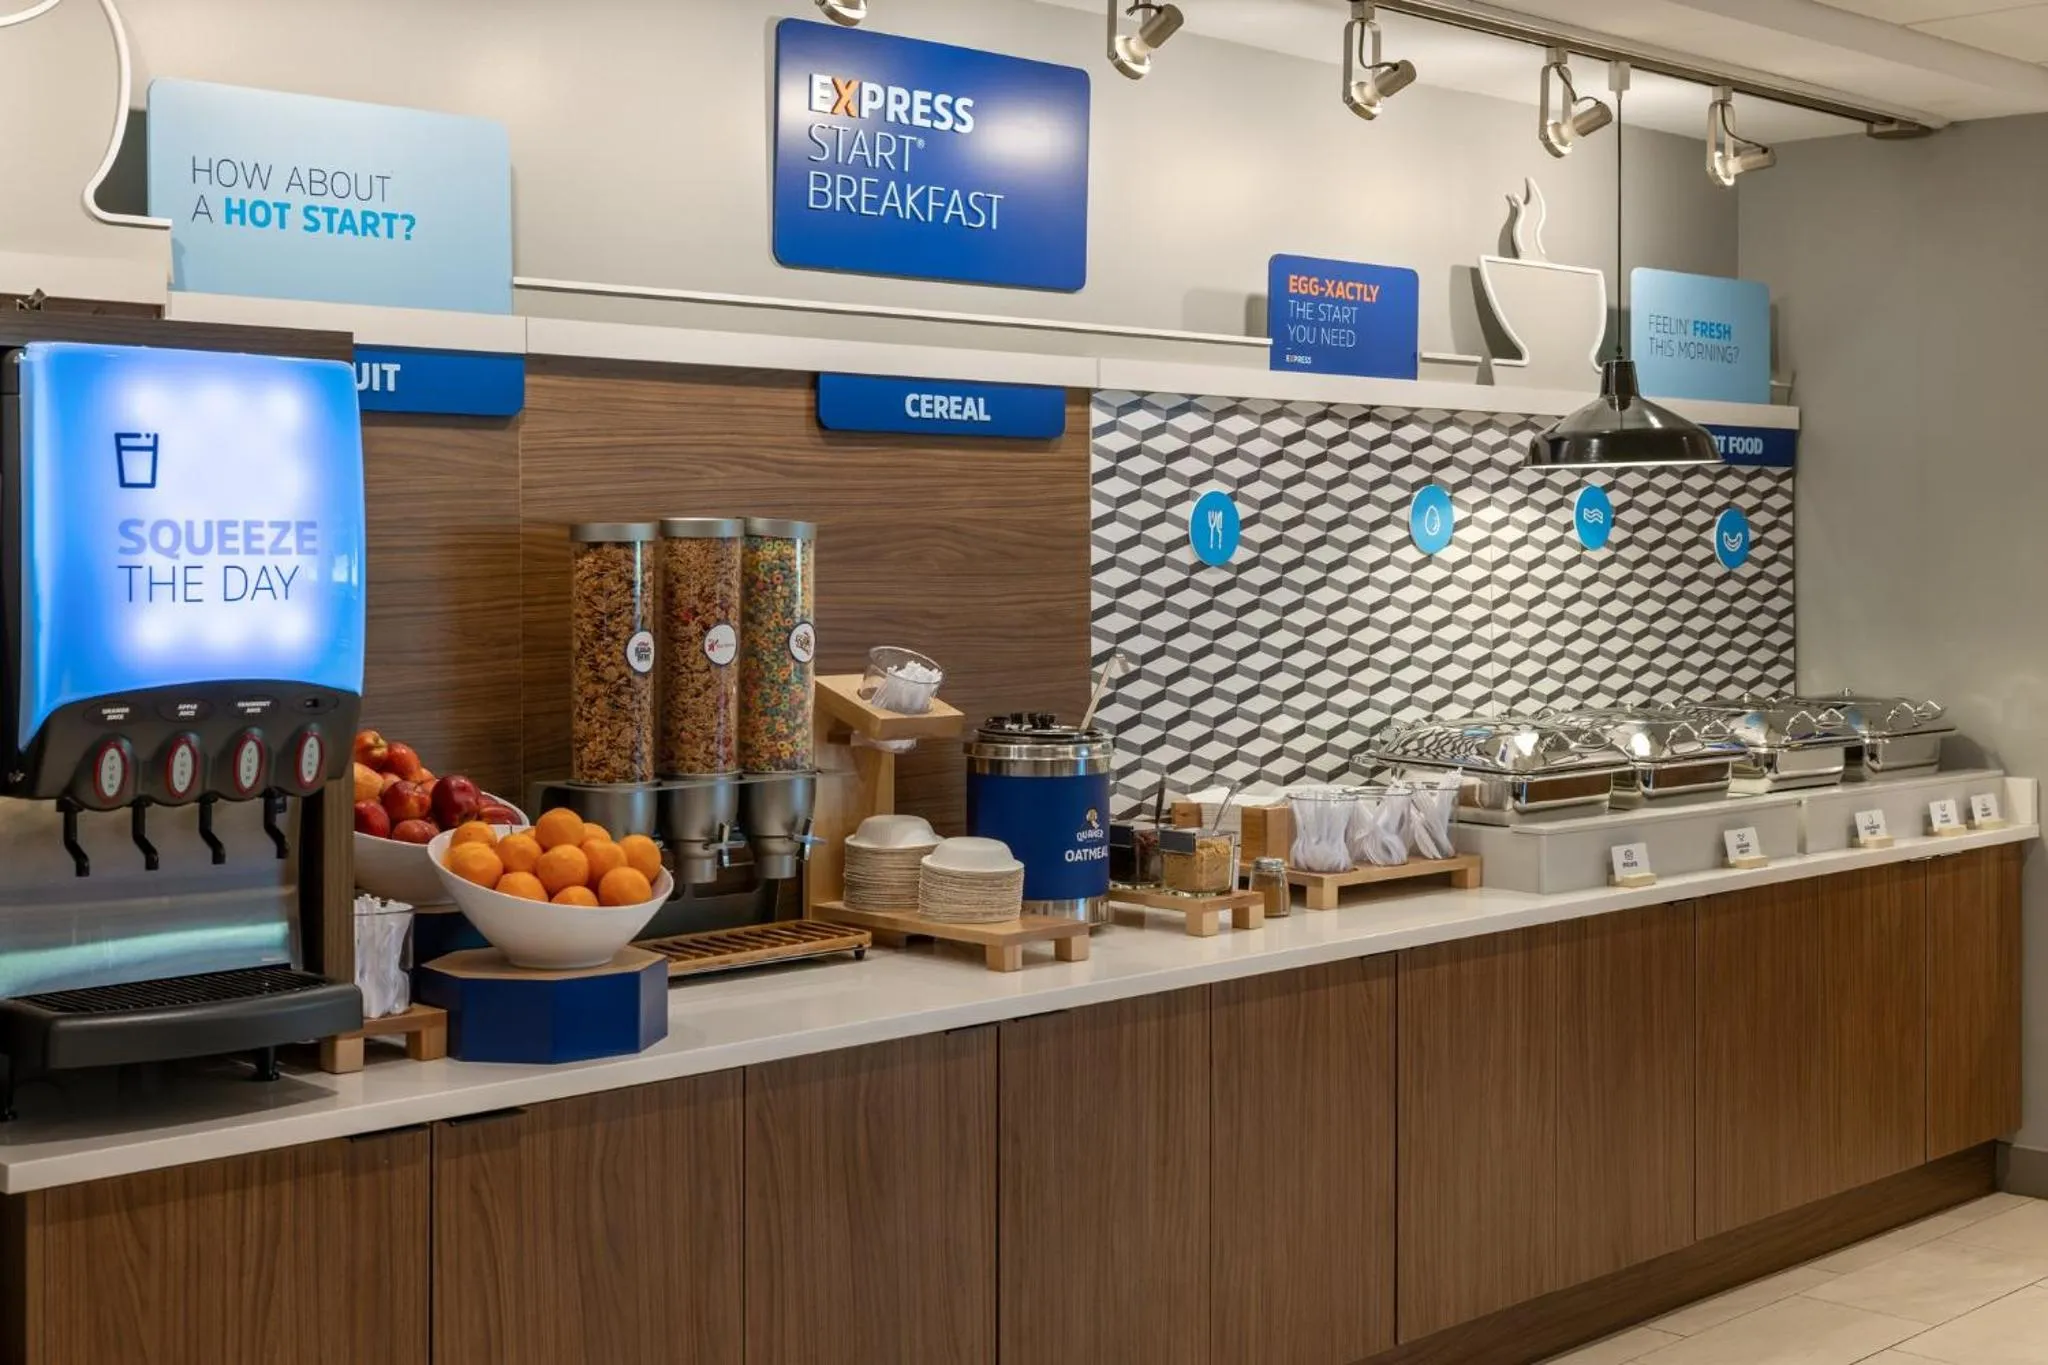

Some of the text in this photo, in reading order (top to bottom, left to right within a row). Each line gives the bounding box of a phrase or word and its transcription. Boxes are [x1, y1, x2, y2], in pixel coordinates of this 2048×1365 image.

[809, 74, 975, 134] EXPRESS
[191, 156, 392, 201] HOW ABOUT
[808, 171, 1004, 230] BREAKFAST
[191, 195, 417, 241] A HOT START?
[1288, 274, 1380, 303] EGG-XACTLY
[1288, 300, 1359, 325] THE START
[1287, 324, 1356, 348] YOU NEED
[1692, 319, 1733, 341] FRESH
[1285, 354, 1312, 365] EXPRESS
[1649, 337, 1740, 365] THIS MORNING?
[353, 362, 402, 392] UIT
[904, 393, 992, 421] CEREAL
[1728, 436, 1764, 455] FOOD
[117, 519, 319, 559] SQUEEZE
[117, 565, 300, 603] THE DAY
[1076, 829, 1105, 842] QUAKER
